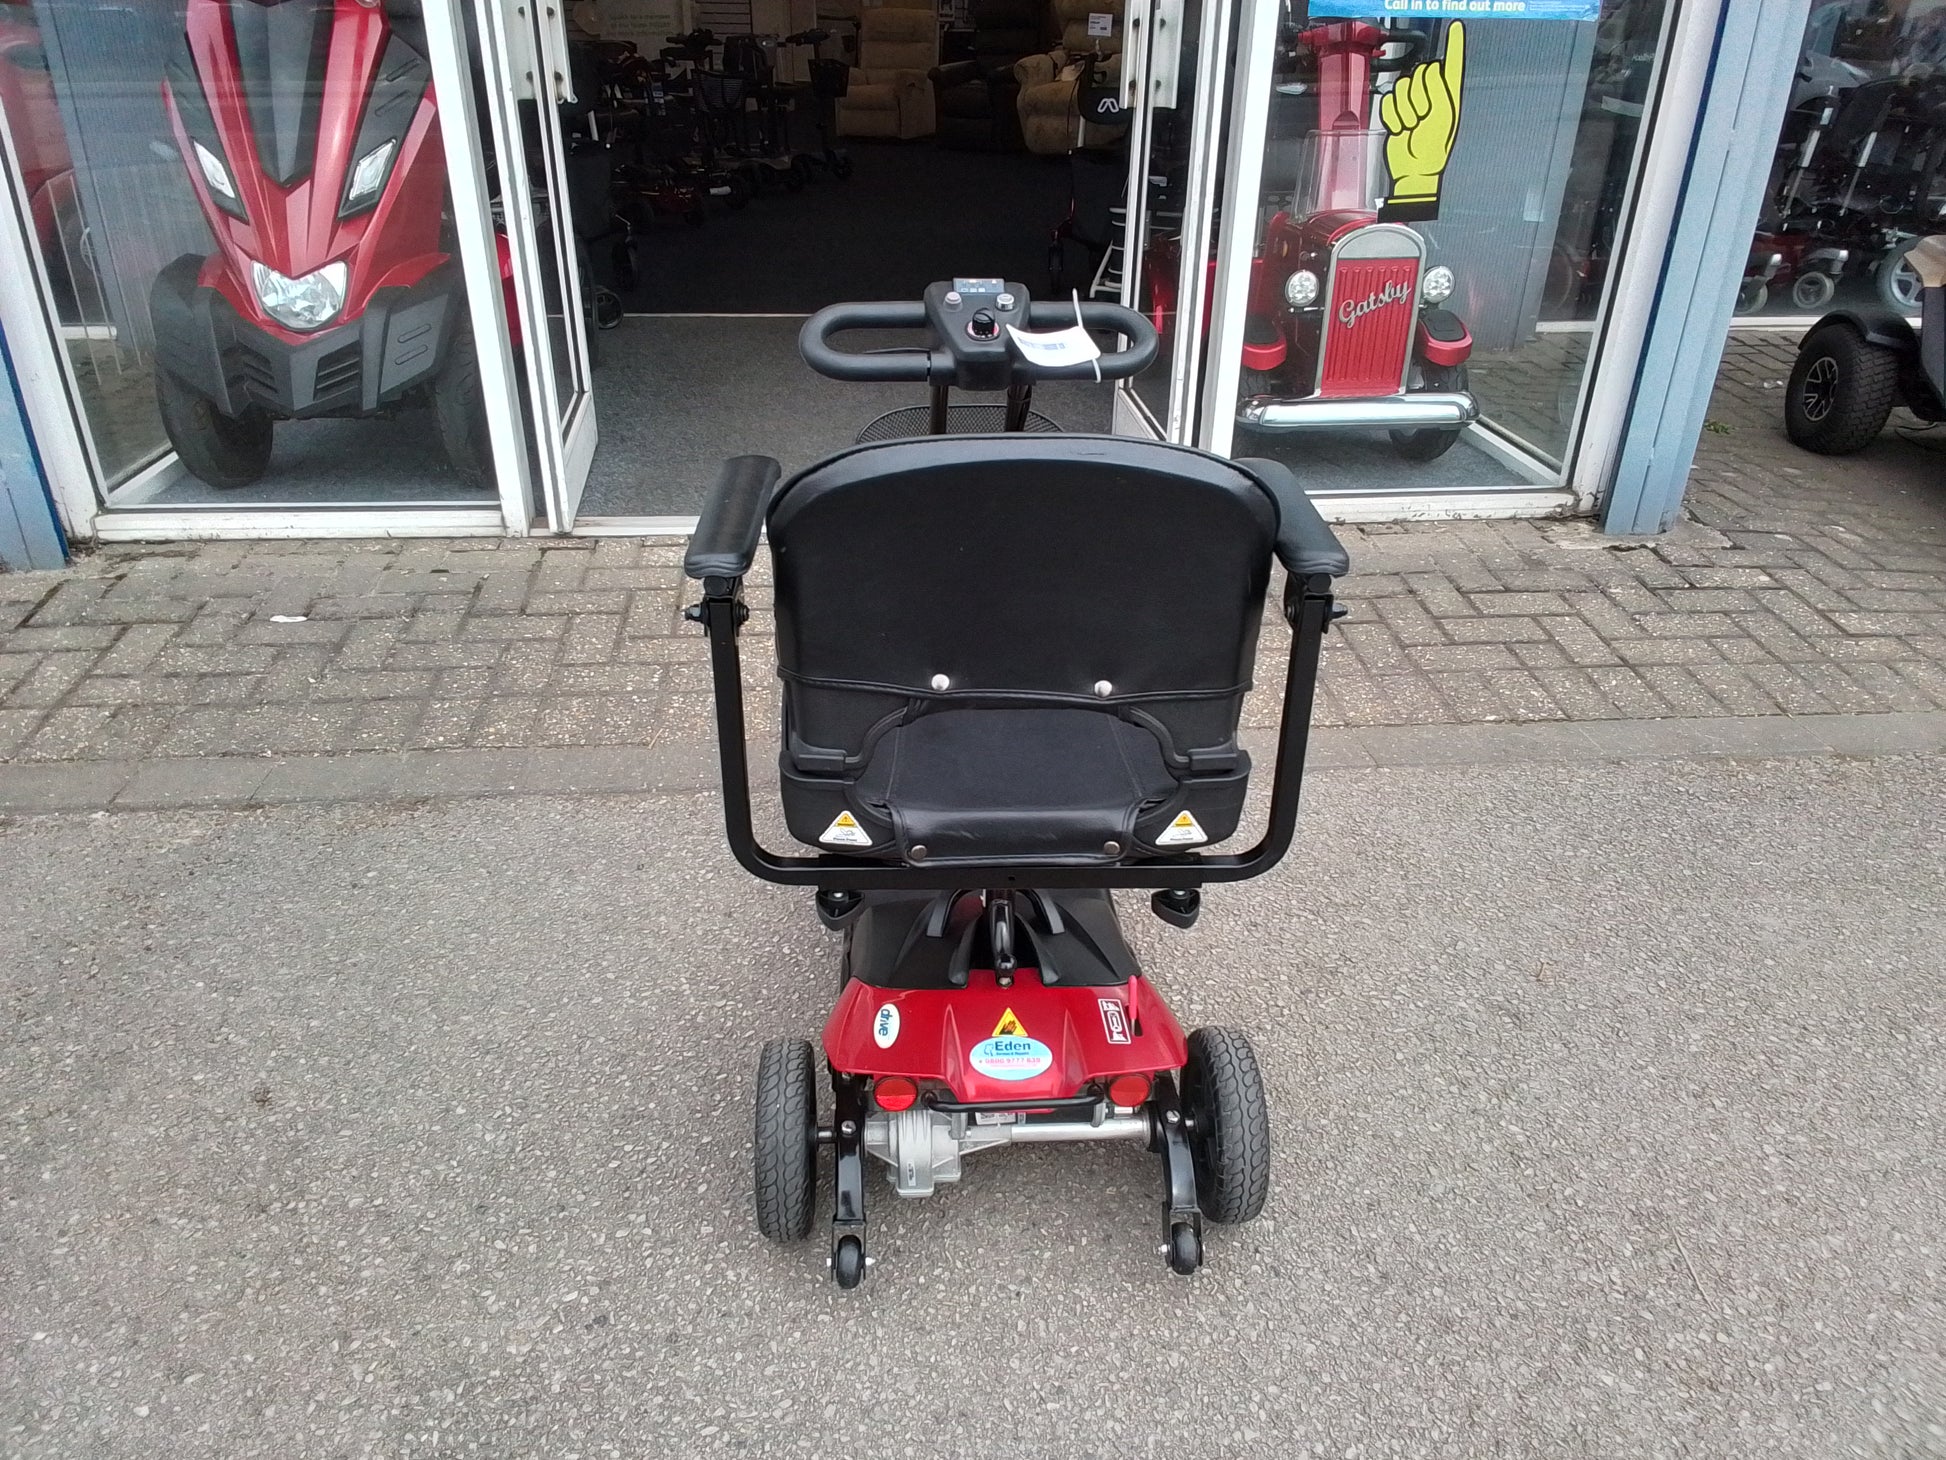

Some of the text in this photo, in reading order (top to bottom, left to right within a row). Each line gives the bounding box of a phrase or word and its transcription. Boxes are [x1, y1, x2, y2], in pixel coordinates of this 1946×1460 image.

[1384, 0, 1408, 10] Call
[1426, 0, 1439, 10] to
[1442, 0, 1467, 11] find
[1469, 1, 1490, 11] out
[1493, 1, 1526, 11] more
[1338, 280, 1411, 328] Gatsby
[878, 1008, 894, 1036] drive
[995, 1041, 1031, 1051] Eden
